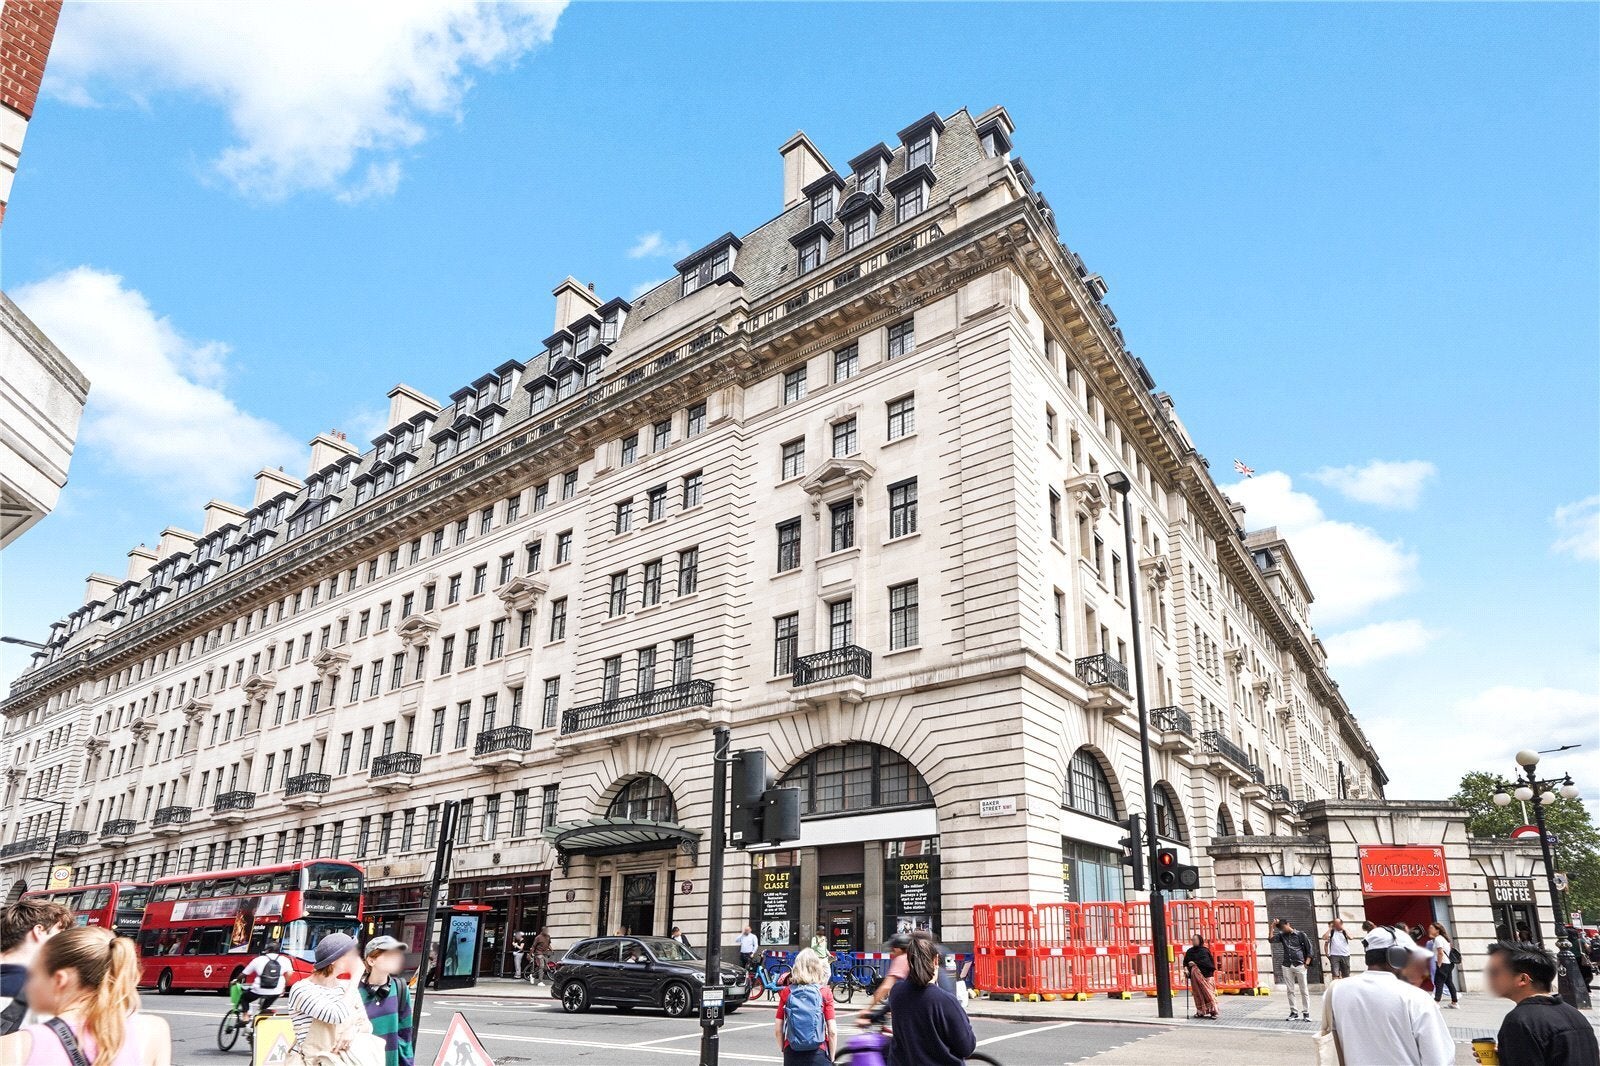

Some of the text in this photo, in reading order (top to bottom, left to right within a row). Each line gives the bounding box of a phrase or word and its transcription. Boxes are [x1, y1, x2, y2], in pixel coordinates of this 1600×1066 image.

[915, 862, 929, 870] 10%
[1367, 864, 1441, 877] WONDERPASS
[764, 872, 790, 881] TO LET
[784, 881, 789, 889] E
[1493, 879, 1529, 888] BLACK SHEEP
[1494, 887, 1532, 901] COFFEE
[340, 902, 353, 913] 274
[451, 920, 473, 928] Google
